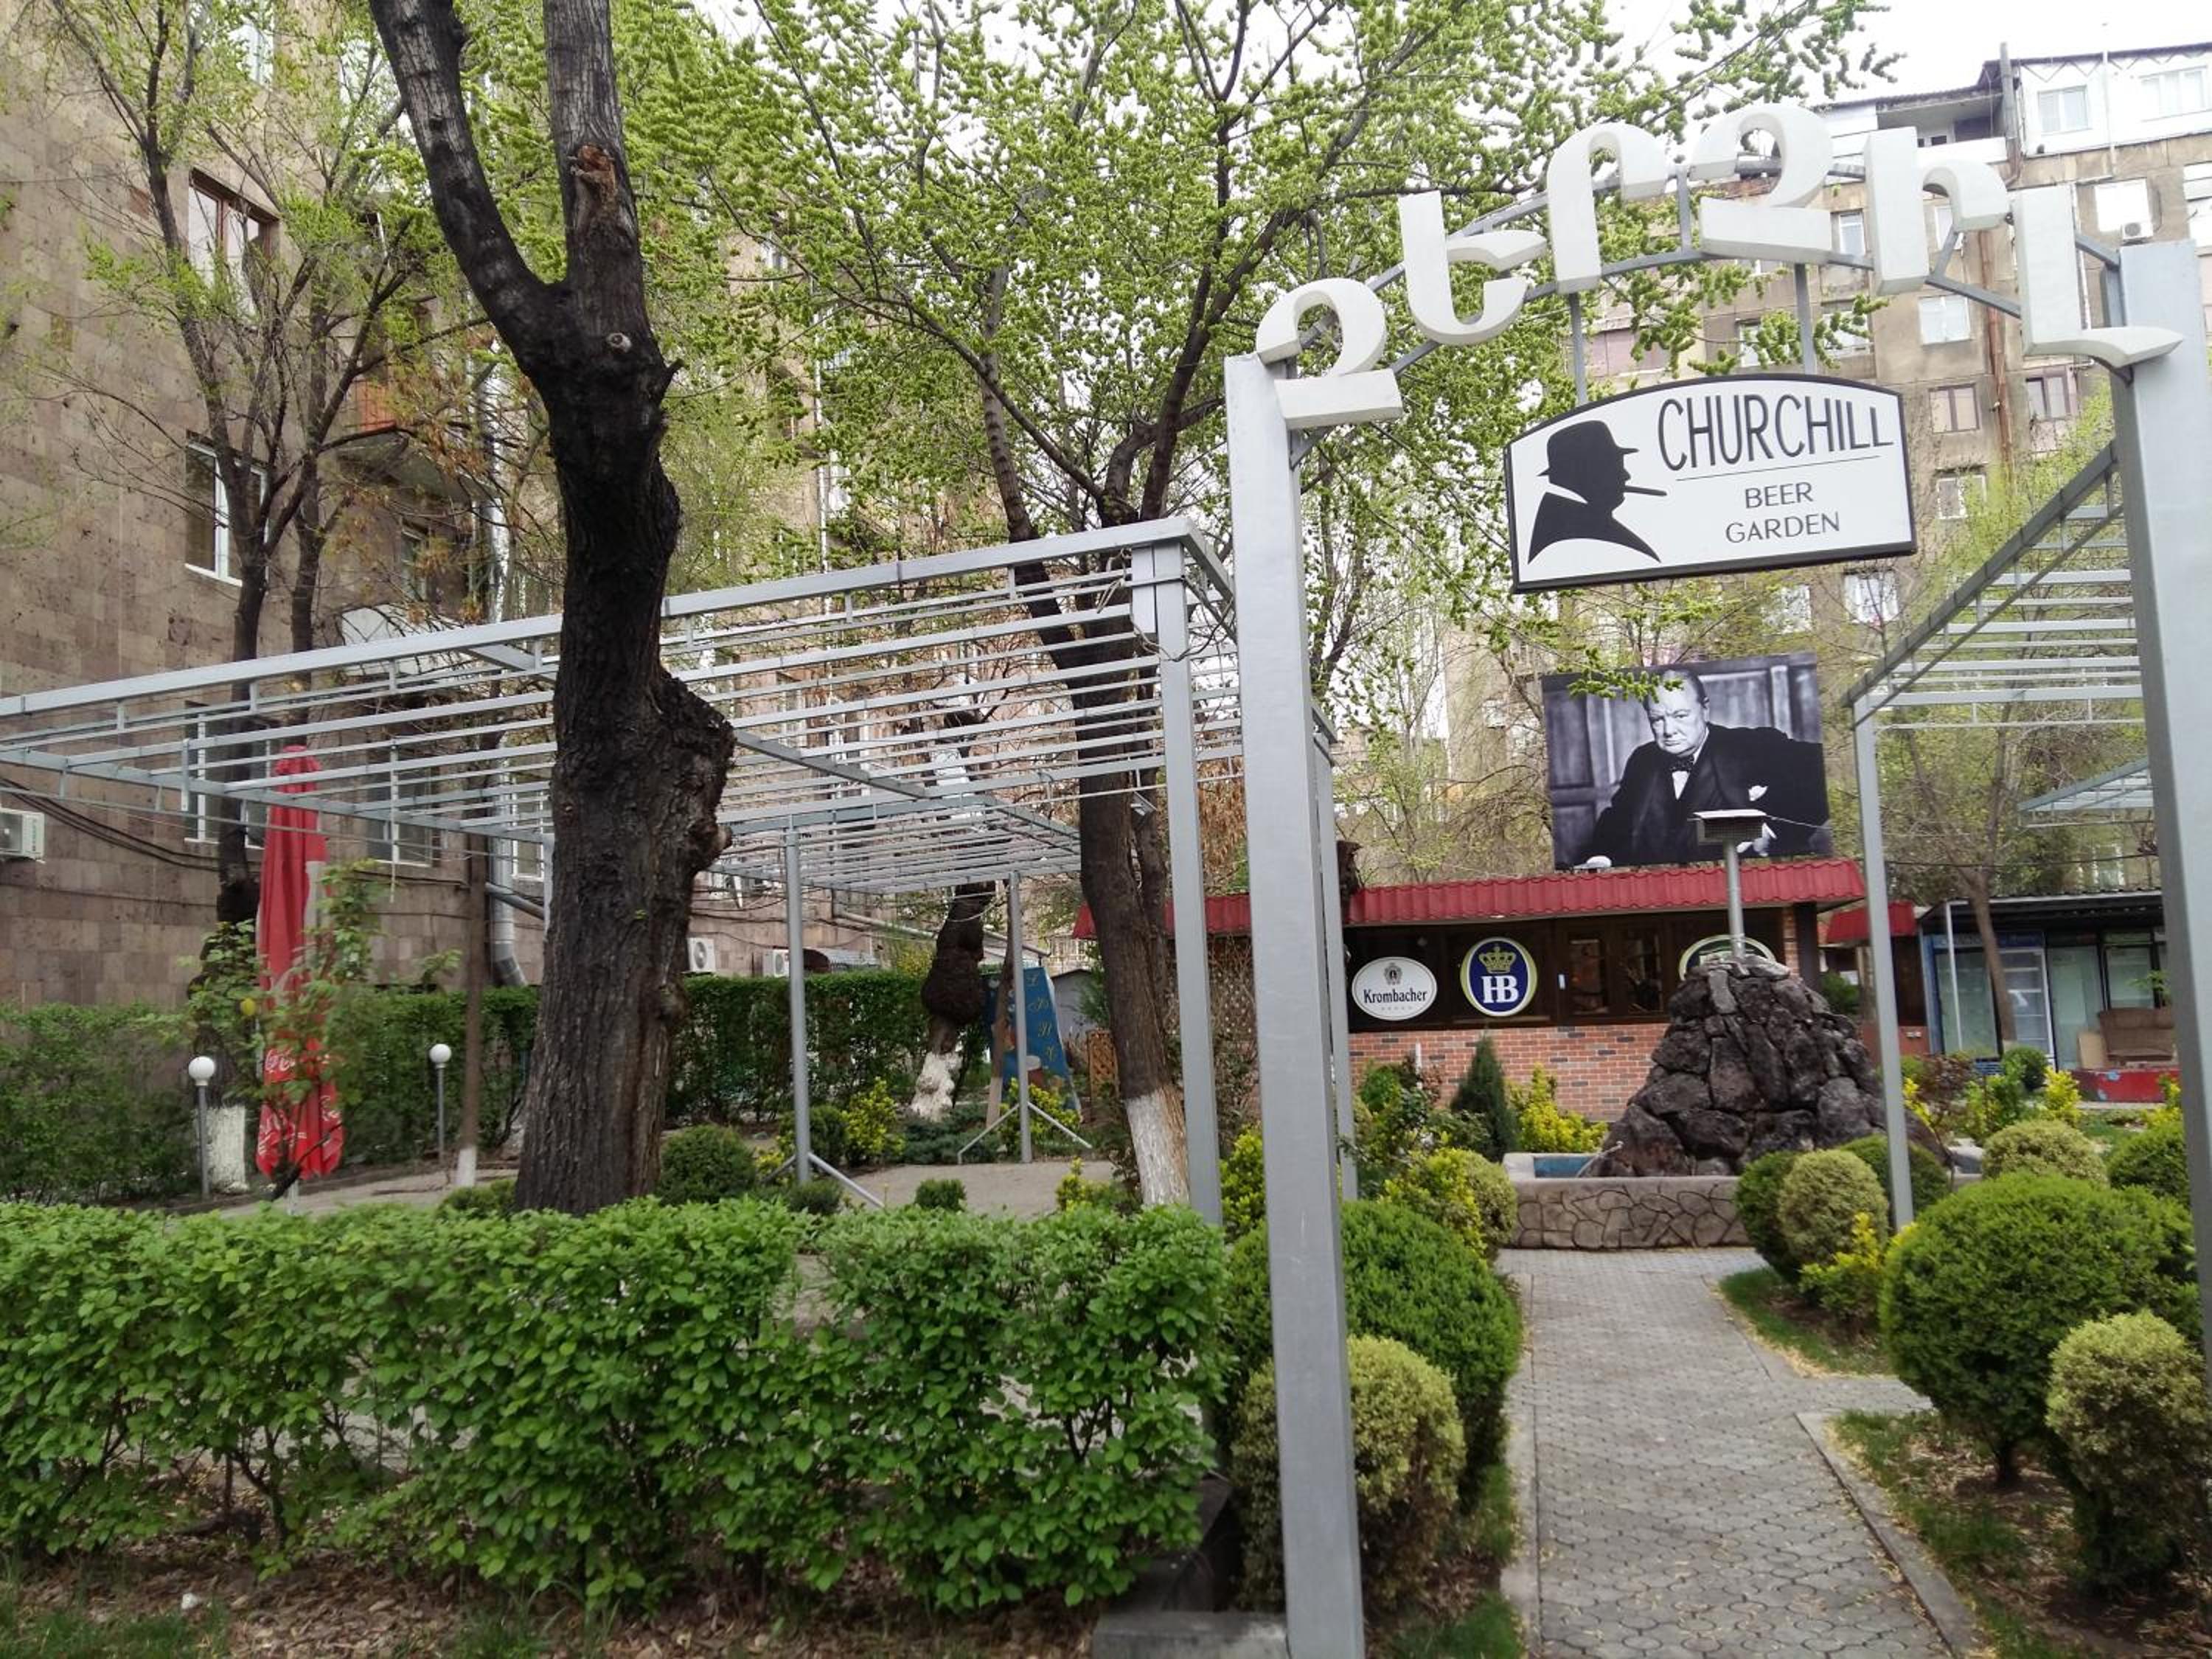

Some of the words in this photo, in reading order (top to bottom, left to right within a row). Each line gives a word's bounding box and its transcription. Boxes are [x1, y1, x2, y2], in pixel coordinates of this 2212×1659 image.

[1658, 394, 1893, 471] CHURCHILL
[1745, 482, 1813, 509] BEER
[1725, 512, 1840, 543] GARDEN
[1363, 988, 1427, 1004] Krombacher
[1481, 975, 1519, 1004] HB
